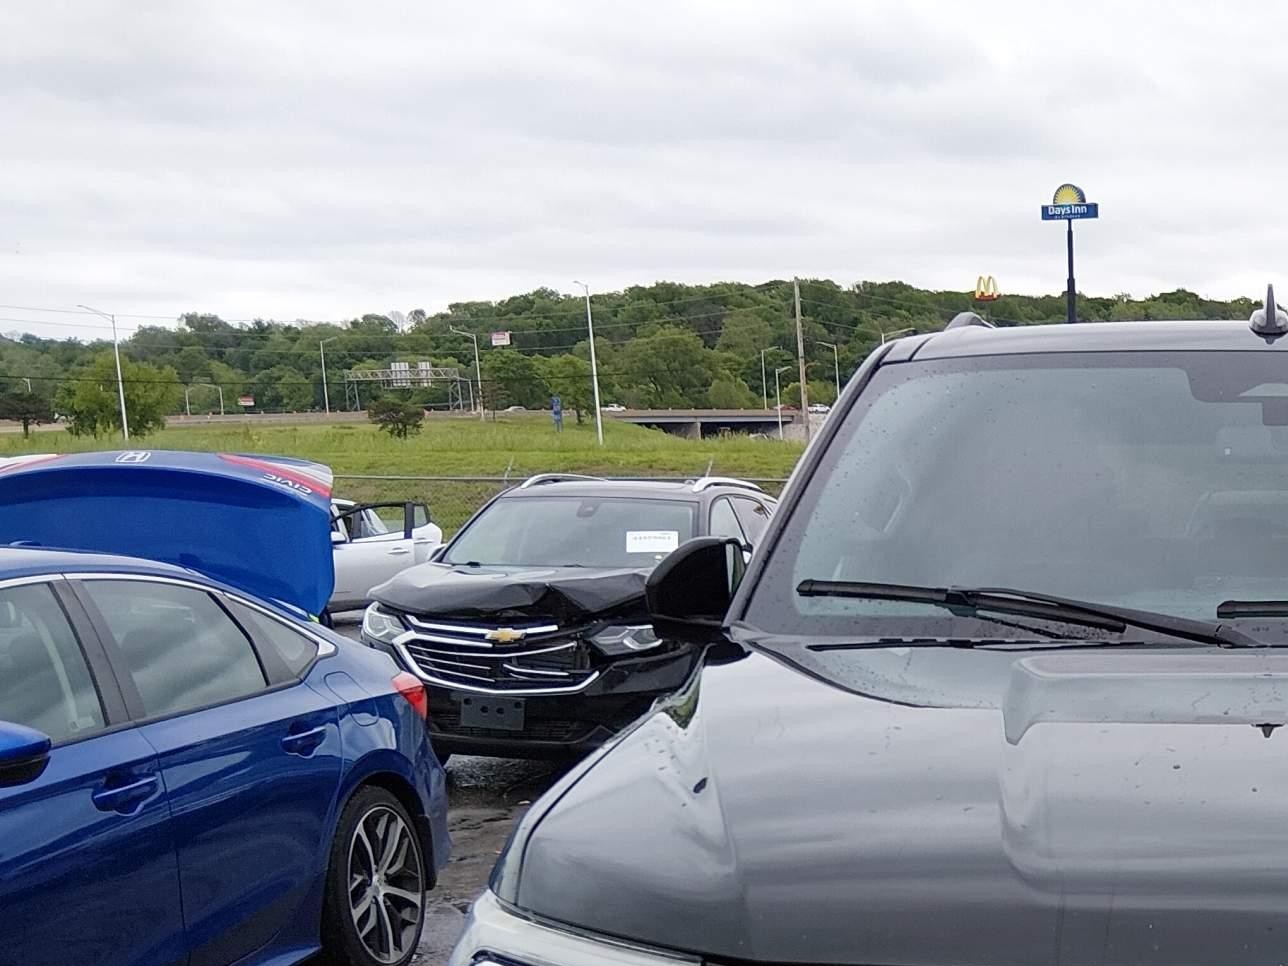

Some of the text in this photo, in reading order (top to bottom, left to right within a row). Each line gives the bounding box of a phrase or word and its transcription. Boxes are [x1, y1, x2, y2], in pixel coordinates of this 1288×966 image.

[1048, 205, 1087, 216] Days Inn
[263, 473, 313, 496] CIVIC
